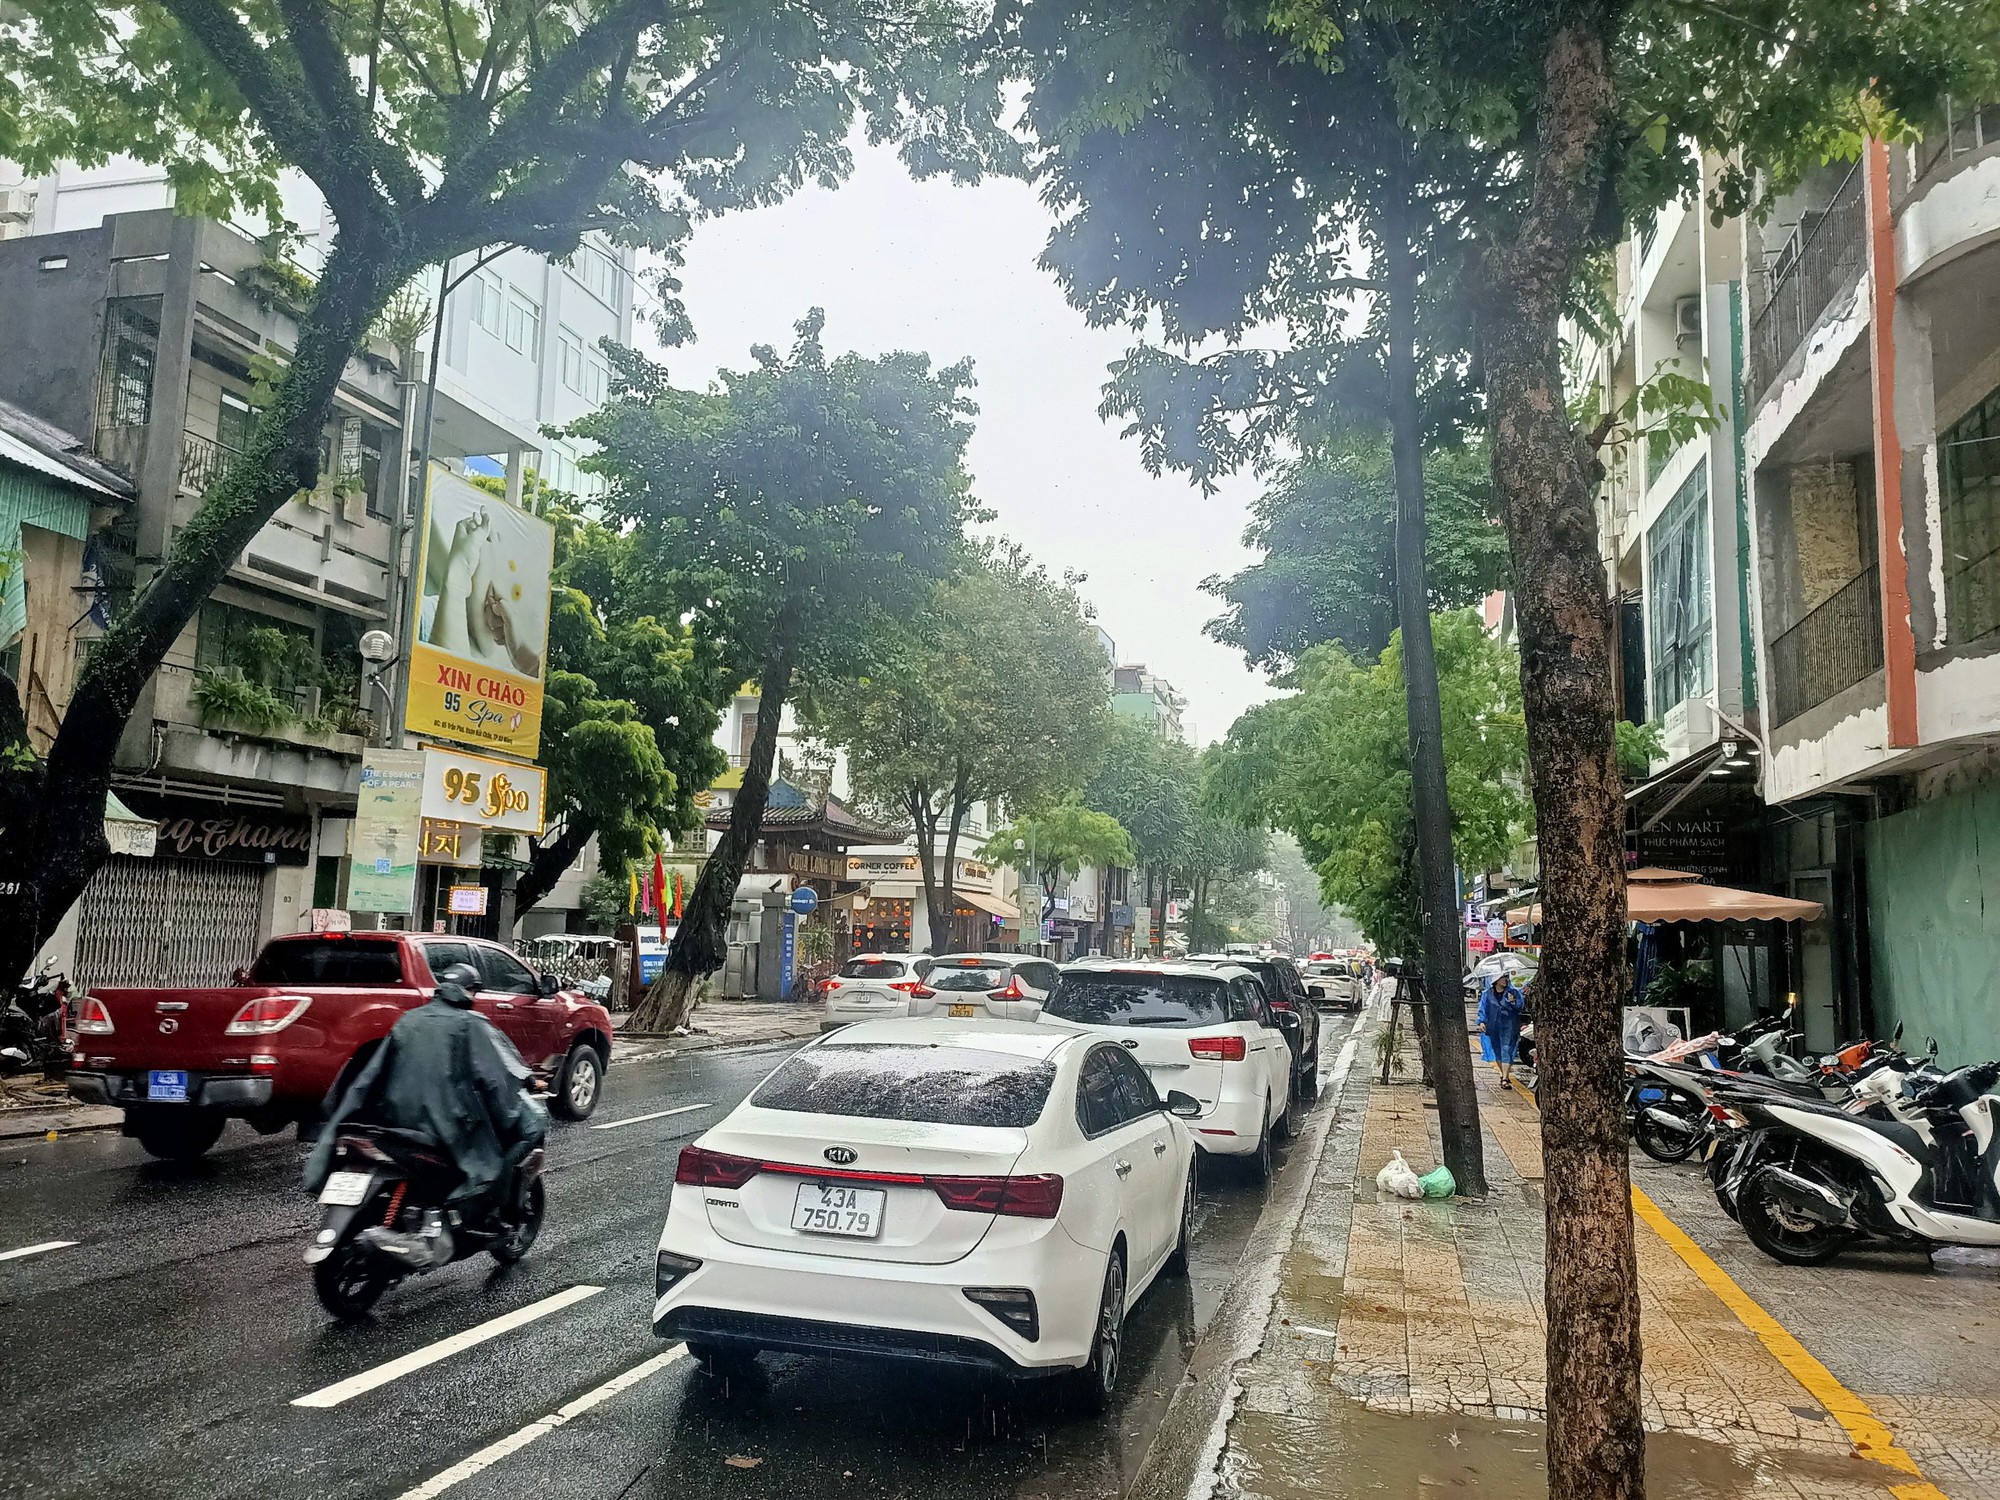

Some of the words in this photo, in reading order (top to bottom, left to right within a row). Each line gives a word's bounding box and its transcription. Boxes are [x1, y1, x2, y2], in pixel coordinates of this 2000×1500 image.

[437, 664, 472, 692] XIN
[476, 678, 526, 707] CHÀO
[444, 691, 461, 713] 95
[464, 699, 504, 728] Spa
[364, 769, 382, 778] THE
[382, 770, 423, 780] ESSENCE
[367, 779, 380, 788] OF
[380, 780, 388, 788] A
[388, 780, 417, 790] PEARL
[443, 767, 481, 805] 95
[1677, 821, 1723, 833] MART
[810, 855, 828, 874] LONG
[848, 862, 882, 870] CORNER
[883, 862, 915, 870] COFFEE
[828, 1150, 852, 1162] KIA
[706, 1198, 739, 1209] CERRATO
[821, 1188, 857, 1210] 43A
[803, 1207, 870, 1233] 750.79
